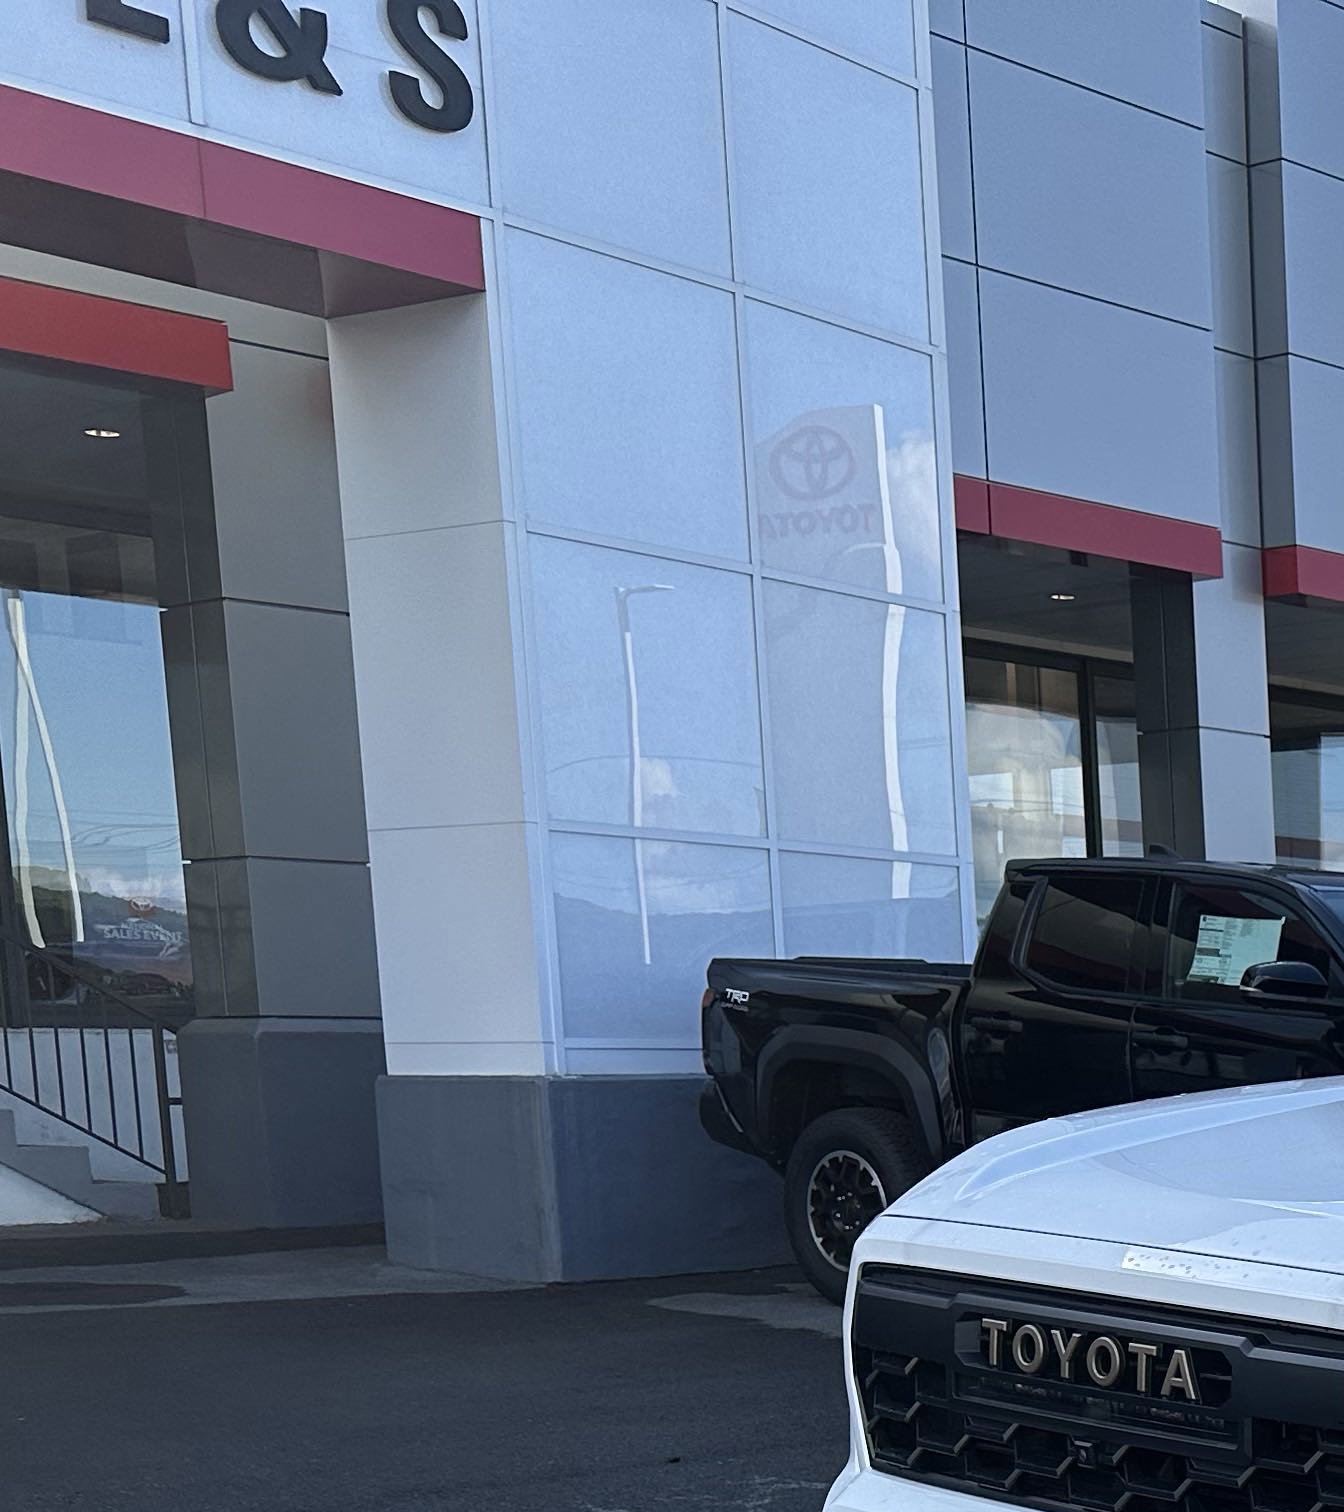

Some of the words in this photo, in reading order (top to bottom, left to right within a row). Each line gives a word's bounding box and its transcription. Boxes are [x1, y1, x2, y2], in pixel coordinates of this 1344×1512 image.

[387, 0, 474, 133] S
[103, 928, 140, 940] SALES
[982, 1318, 1197, 1401] TOYOTA
